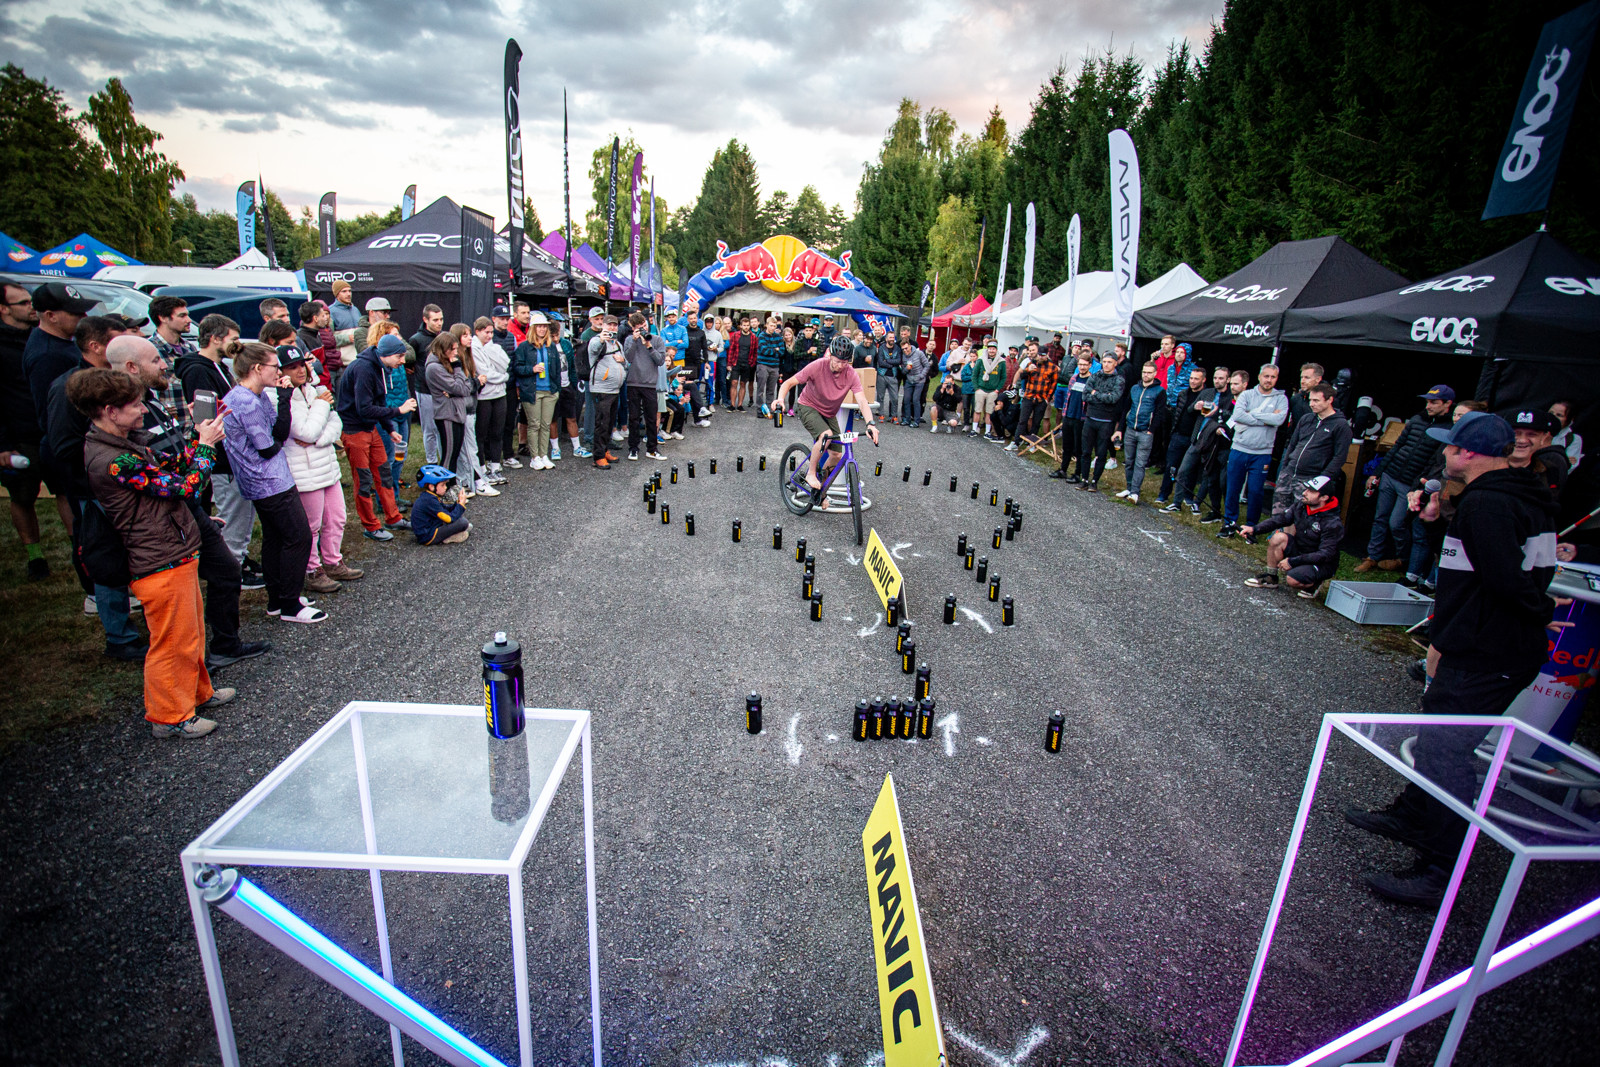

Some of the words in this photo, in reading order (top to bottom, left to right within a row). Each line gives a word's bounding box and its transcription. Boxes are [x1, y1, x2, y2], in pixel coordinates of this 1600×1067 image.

[315, 271, 357, 283] GIRO
[472, 268, 487, 279] SAGA
[1224, 320, 1269, 338] FIDLOCK
[868, 546, 895, 597] MAVIC
[483, 680, 494, 728] MAVIC
[872, 831, 922, 1045] MAVIC
